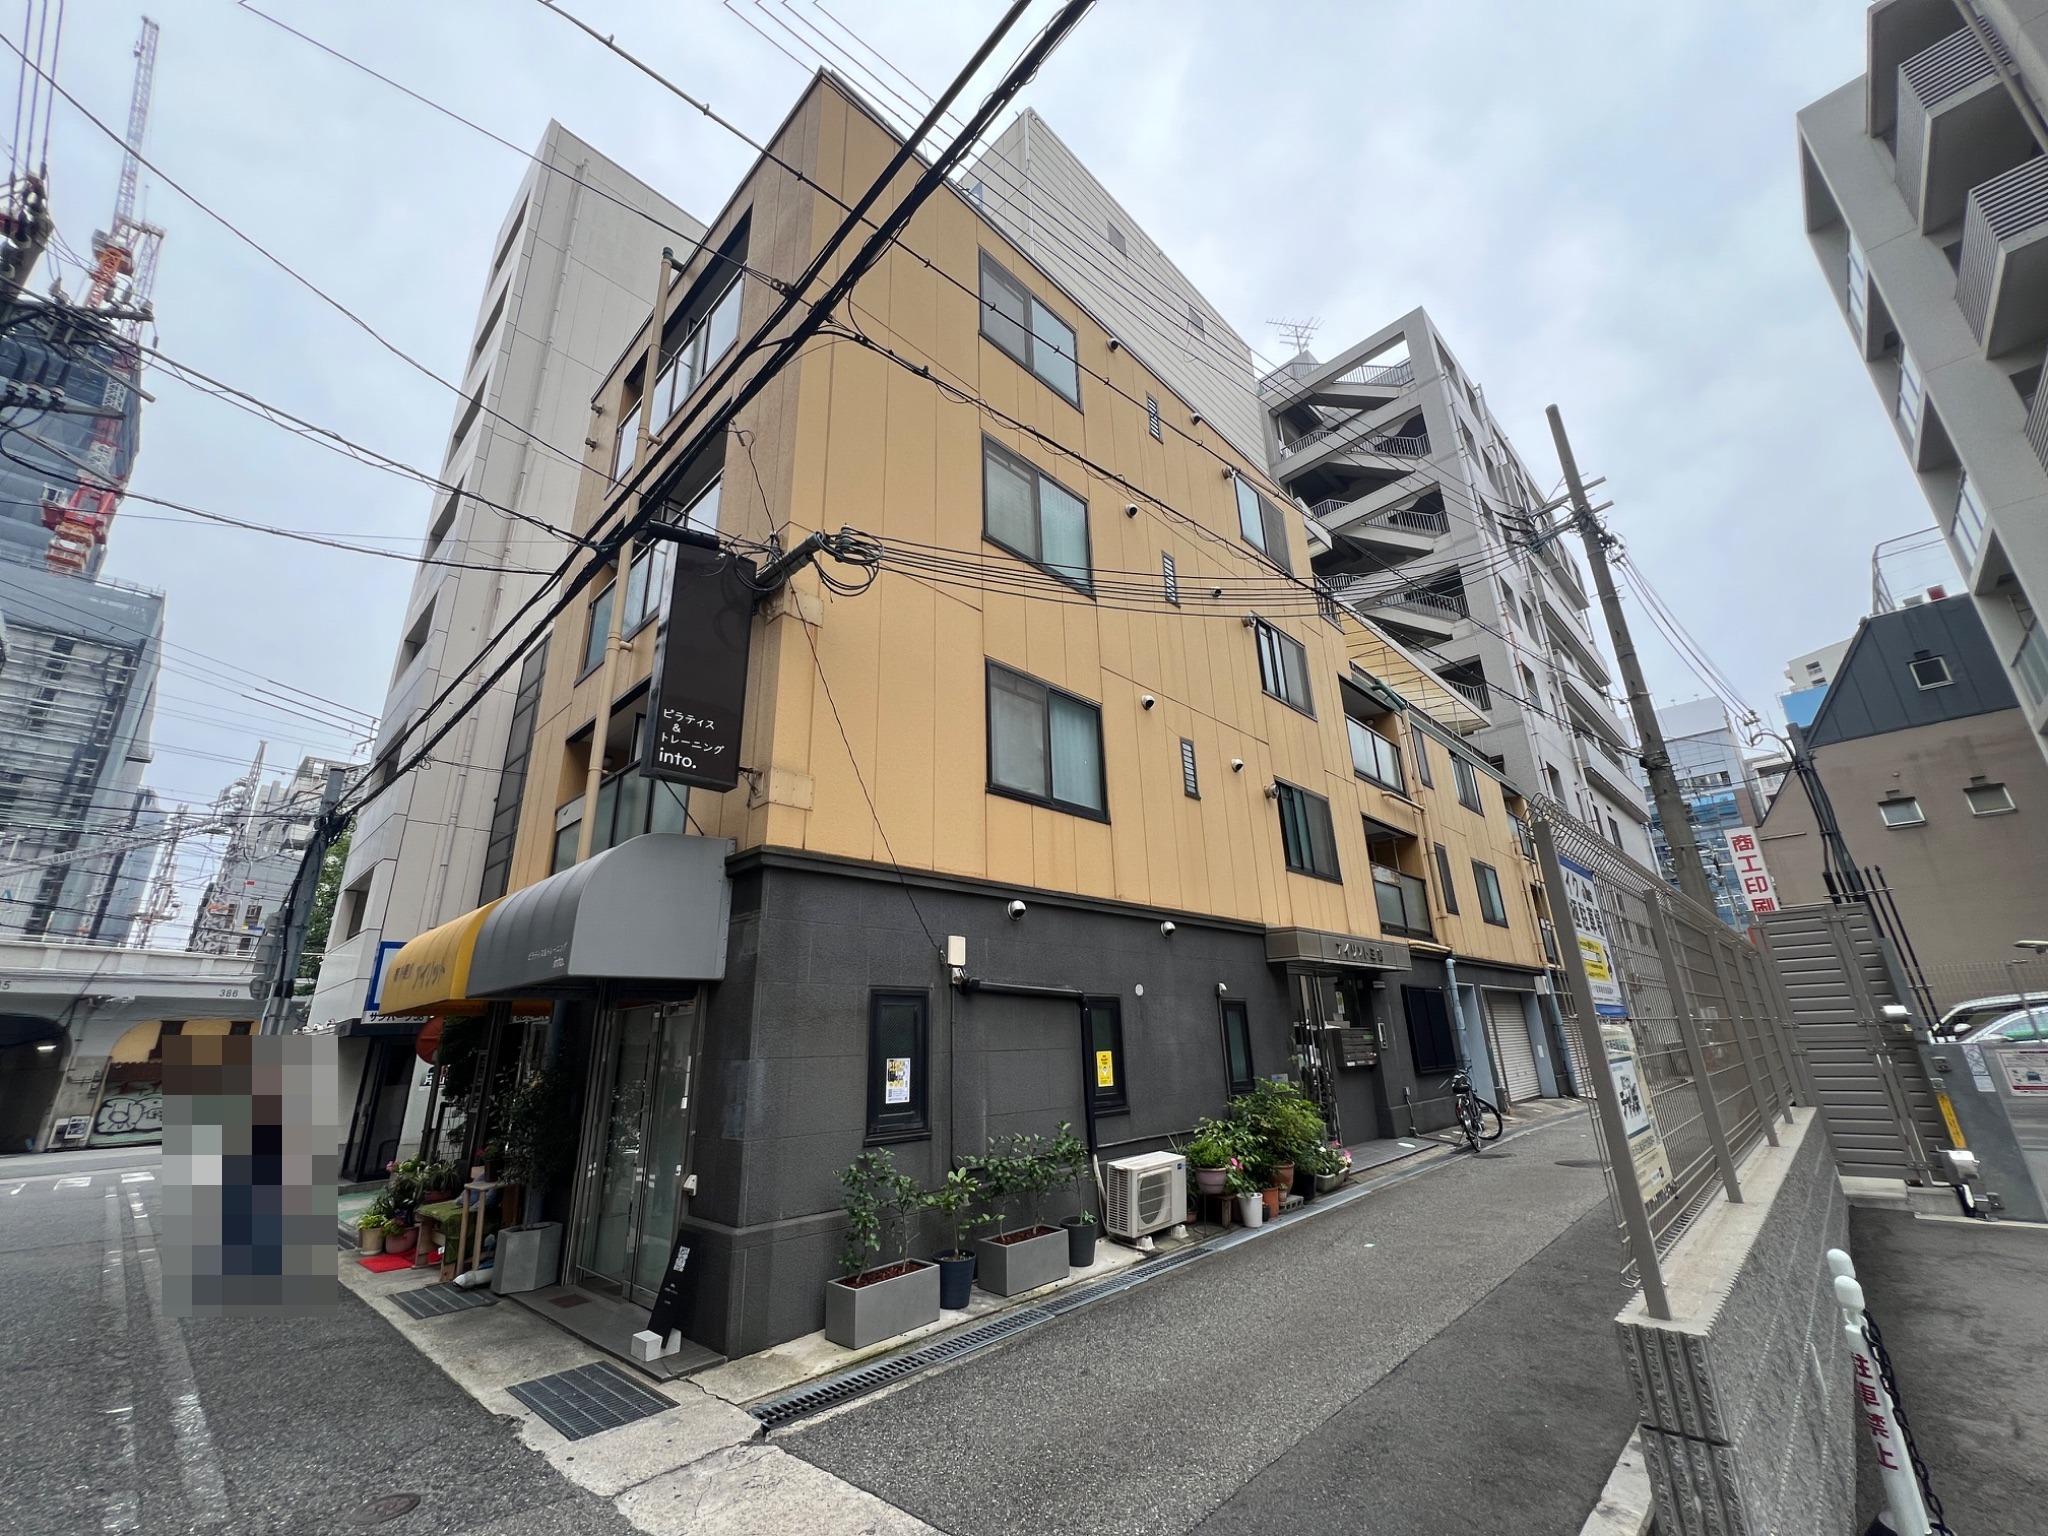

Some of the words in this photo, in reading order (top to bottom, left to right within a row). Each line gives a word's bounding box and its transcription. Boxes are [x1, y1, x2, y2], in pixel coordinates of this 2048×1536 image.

[663, 708, 715, 730] ピラティス
[672, 723, 681, 733] &
[661, 732, 725, 755] トレーニング
[659, 746, 697, 769] into.
[1730, 834, 1776, 913] 商工印刷
[219, 988, 239, 998] 386
